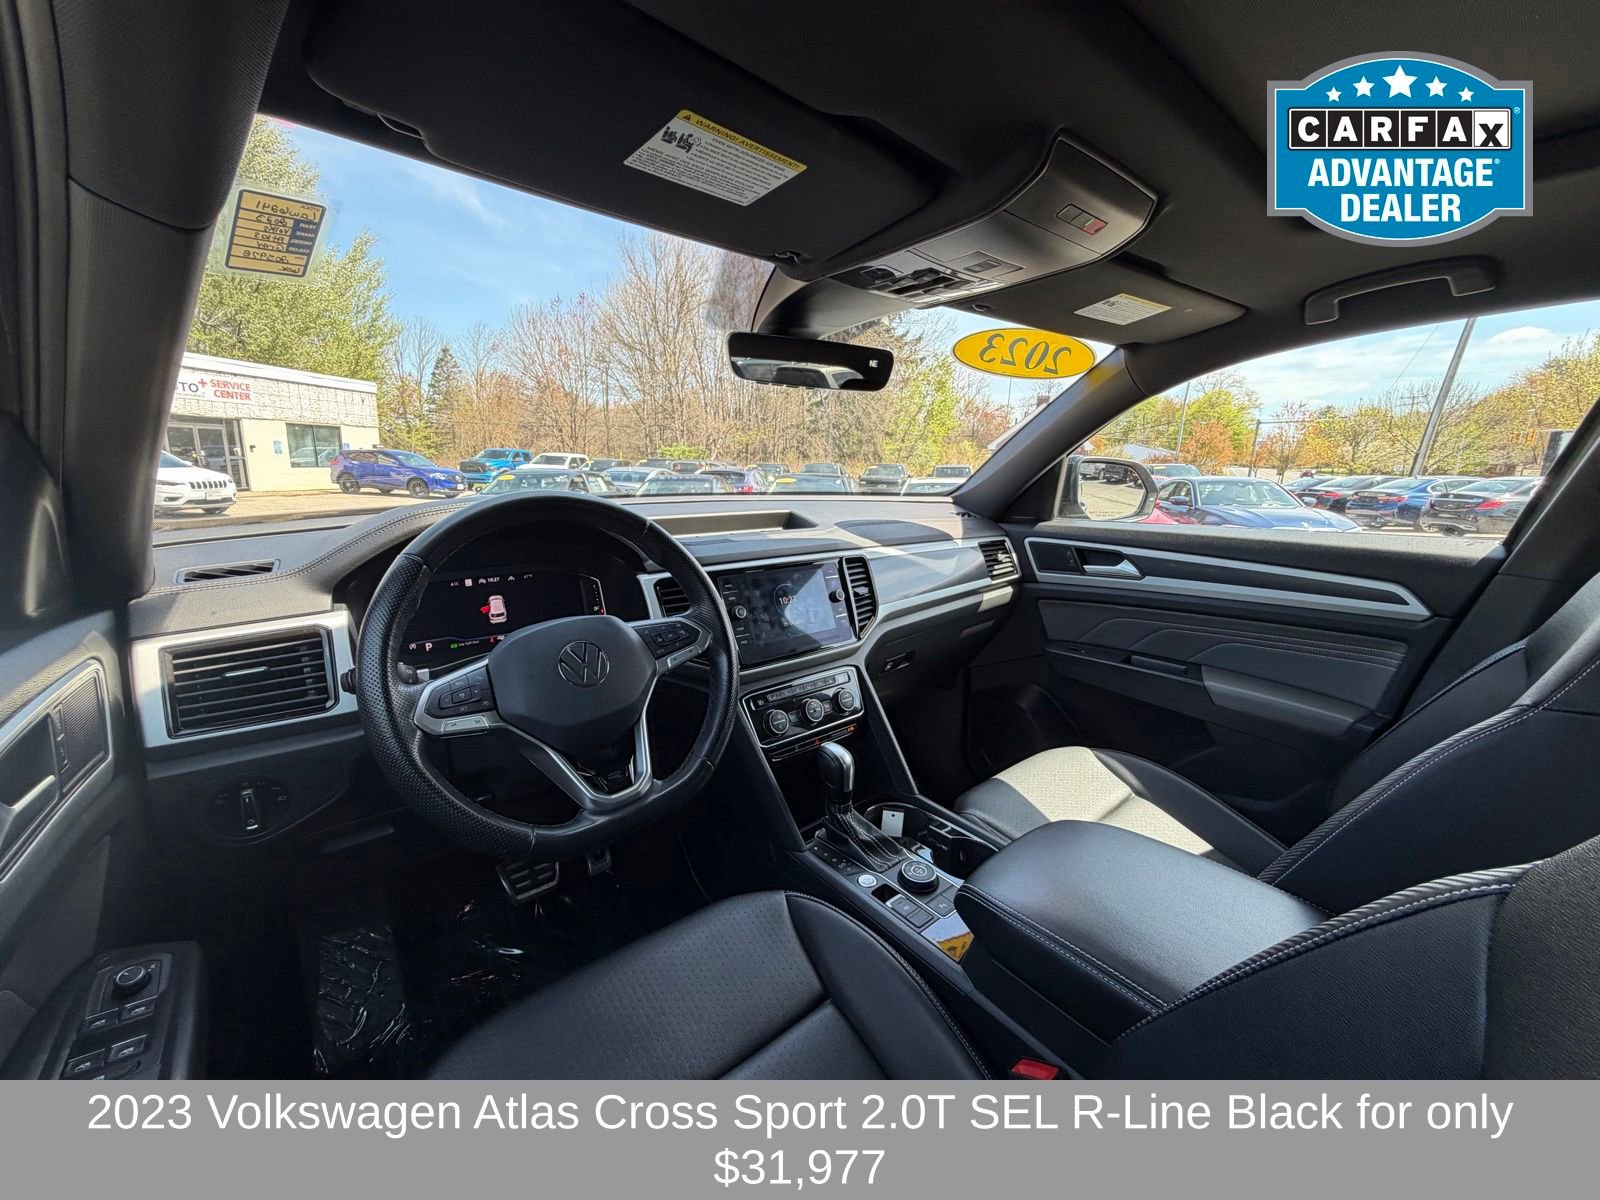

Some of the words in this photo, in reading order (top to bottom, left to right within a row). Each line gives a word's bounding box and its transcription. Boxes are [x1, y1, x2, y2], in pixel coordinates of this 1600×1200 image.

[693, 119, 739, 141] WARNING!
[209, 380, 251, 391] SERVICE
[214, 390, 251, 401] CENTER
